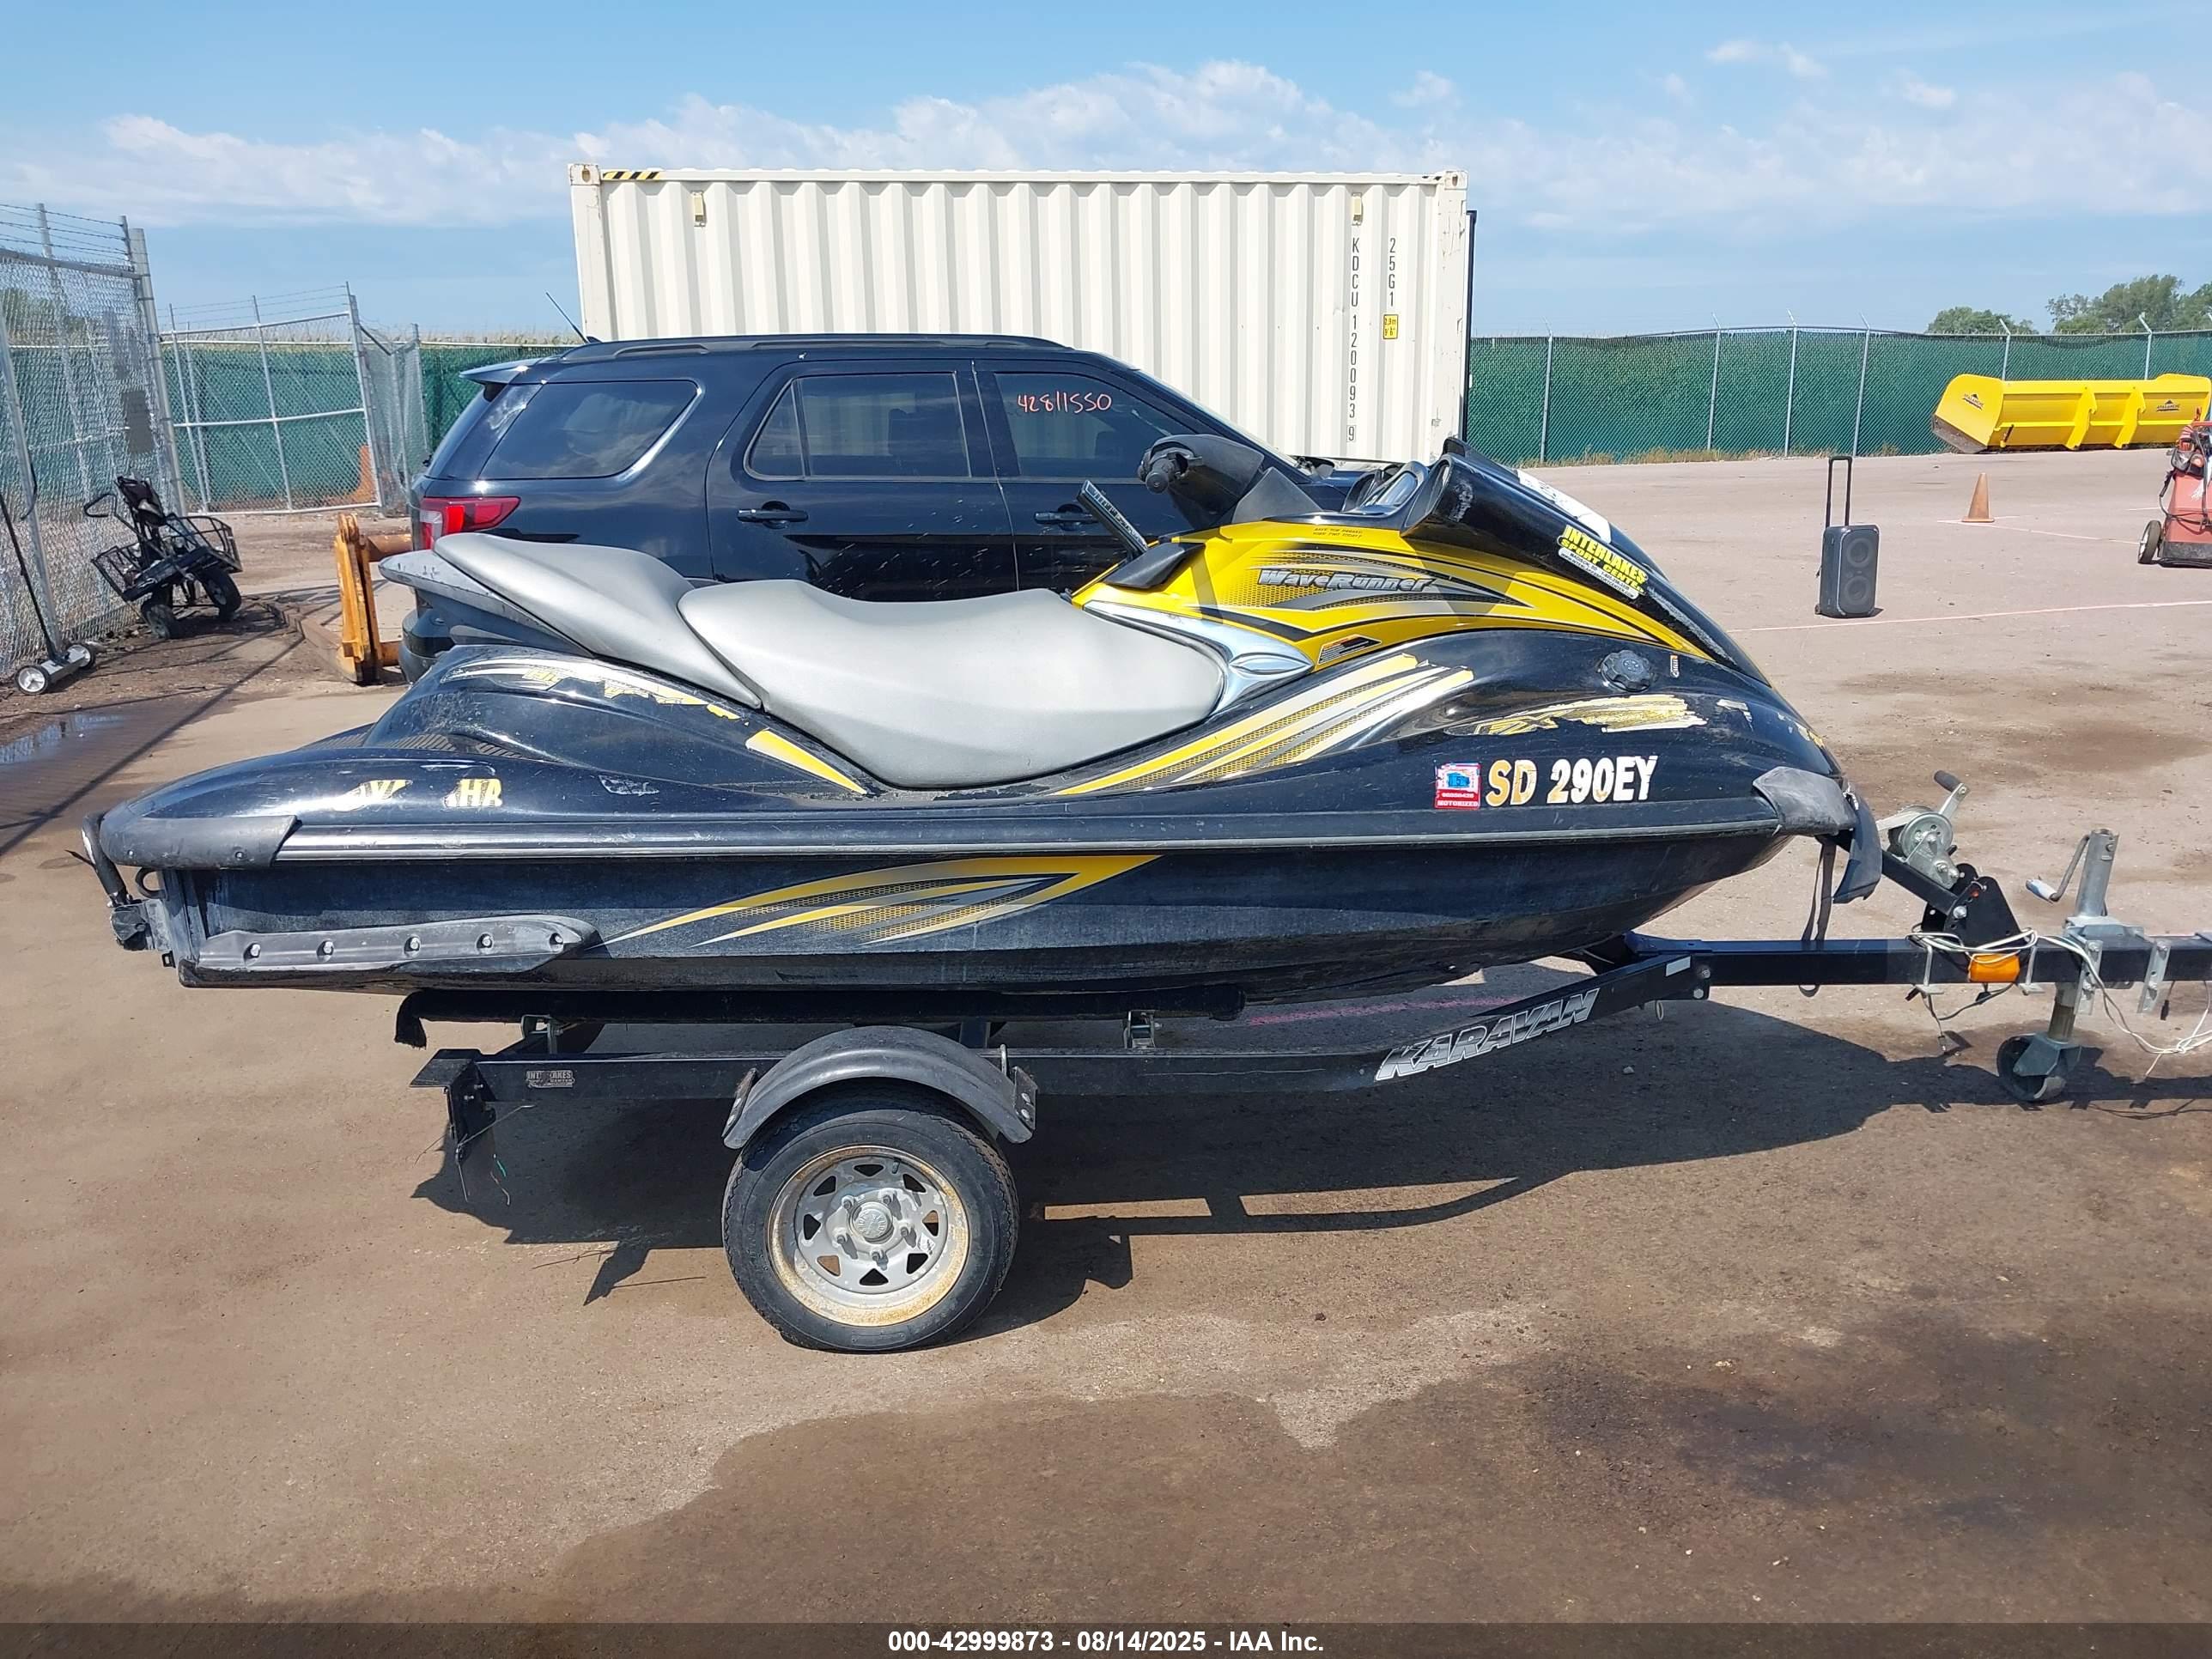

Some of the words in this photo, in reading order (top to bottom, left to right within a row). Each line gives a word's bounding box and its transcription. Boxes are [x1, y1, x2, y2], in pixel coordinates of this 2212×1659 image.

[1351, 237, 1359, 307] KDCU
[1349, 314, 1358, 418] 120093
[1348, 426, 1355, 441] 9
[1561, 538, 1601, 565] SPORT
[1563, 525, 1647, 584] INTERLAKES
[1259, 568, 1435, 592] WaveRunner
[1486, 759, 1538, 807] SD
[1546, 755, 1658, 805] 290EY
[1376, 988, 1600, 1081] KARAVAN
